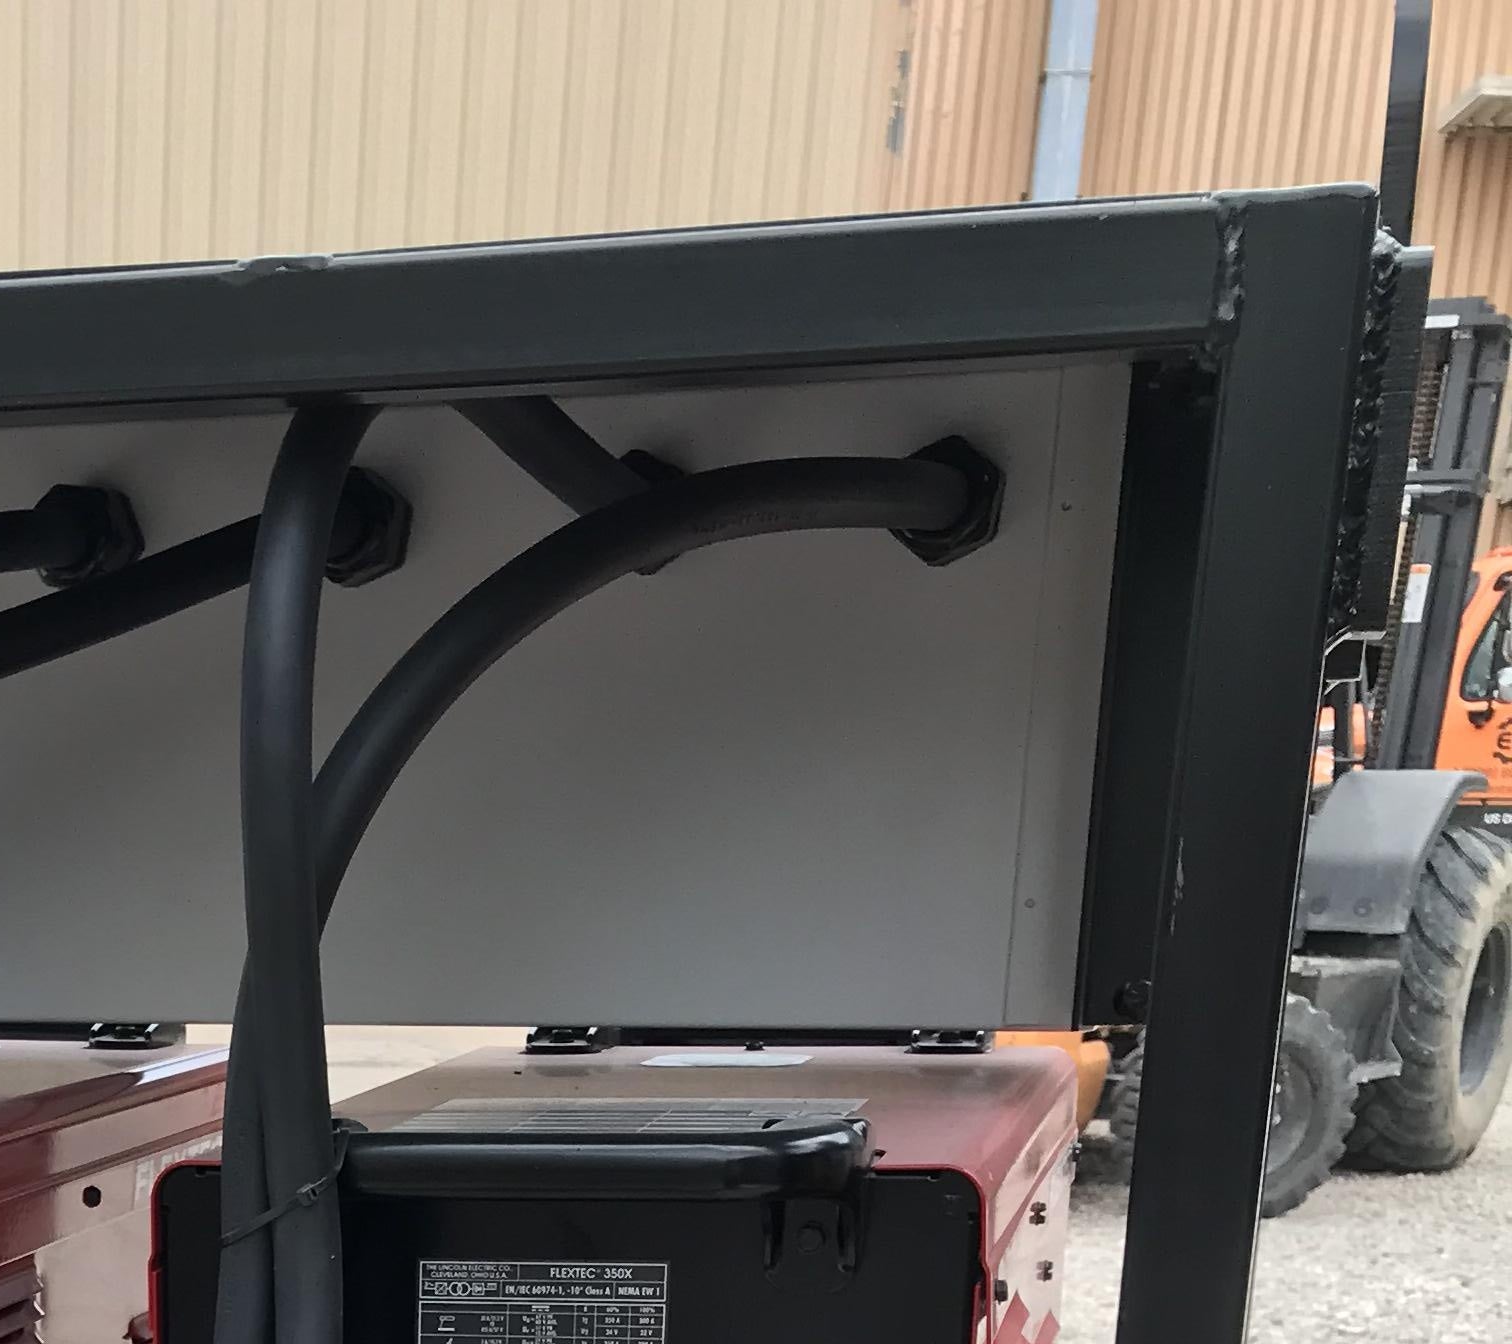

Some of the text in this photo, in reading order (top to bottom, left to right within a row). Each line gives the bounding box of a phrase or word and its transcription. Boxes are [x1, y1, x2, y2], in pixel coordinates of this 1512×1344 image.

[604, 1268, 633, 1279] 350X
[585, 1286, 604, 1295] Class
[605, 1287, 611, 1295] A
[618, 1287, 640, 1296] NEMA
